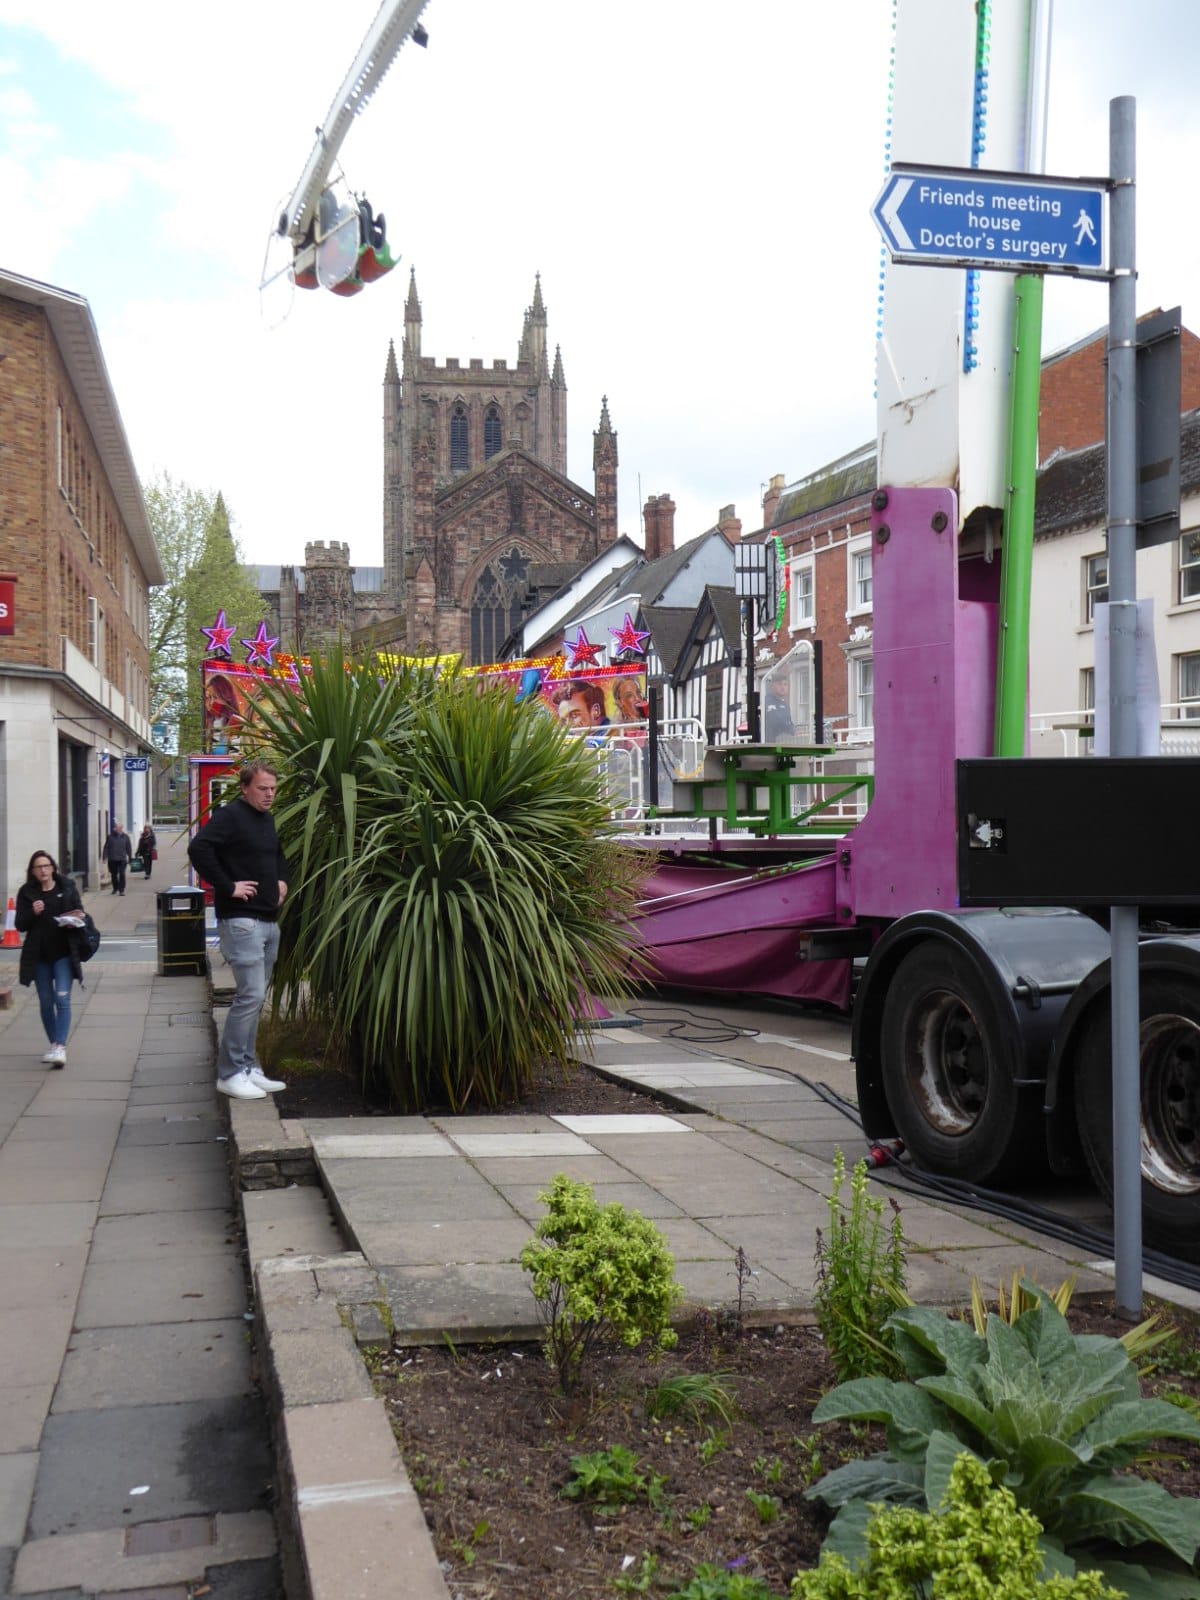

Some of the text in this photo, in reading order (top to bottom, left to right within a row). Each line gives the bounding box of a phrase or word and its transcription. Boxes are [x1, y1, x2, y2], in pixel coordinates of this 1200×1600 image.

[920, 187, 1062, 217] Friends meeting
[968, 211, 1022, 231] house
[920, 228, 1068, 259] Doctor's surgery
